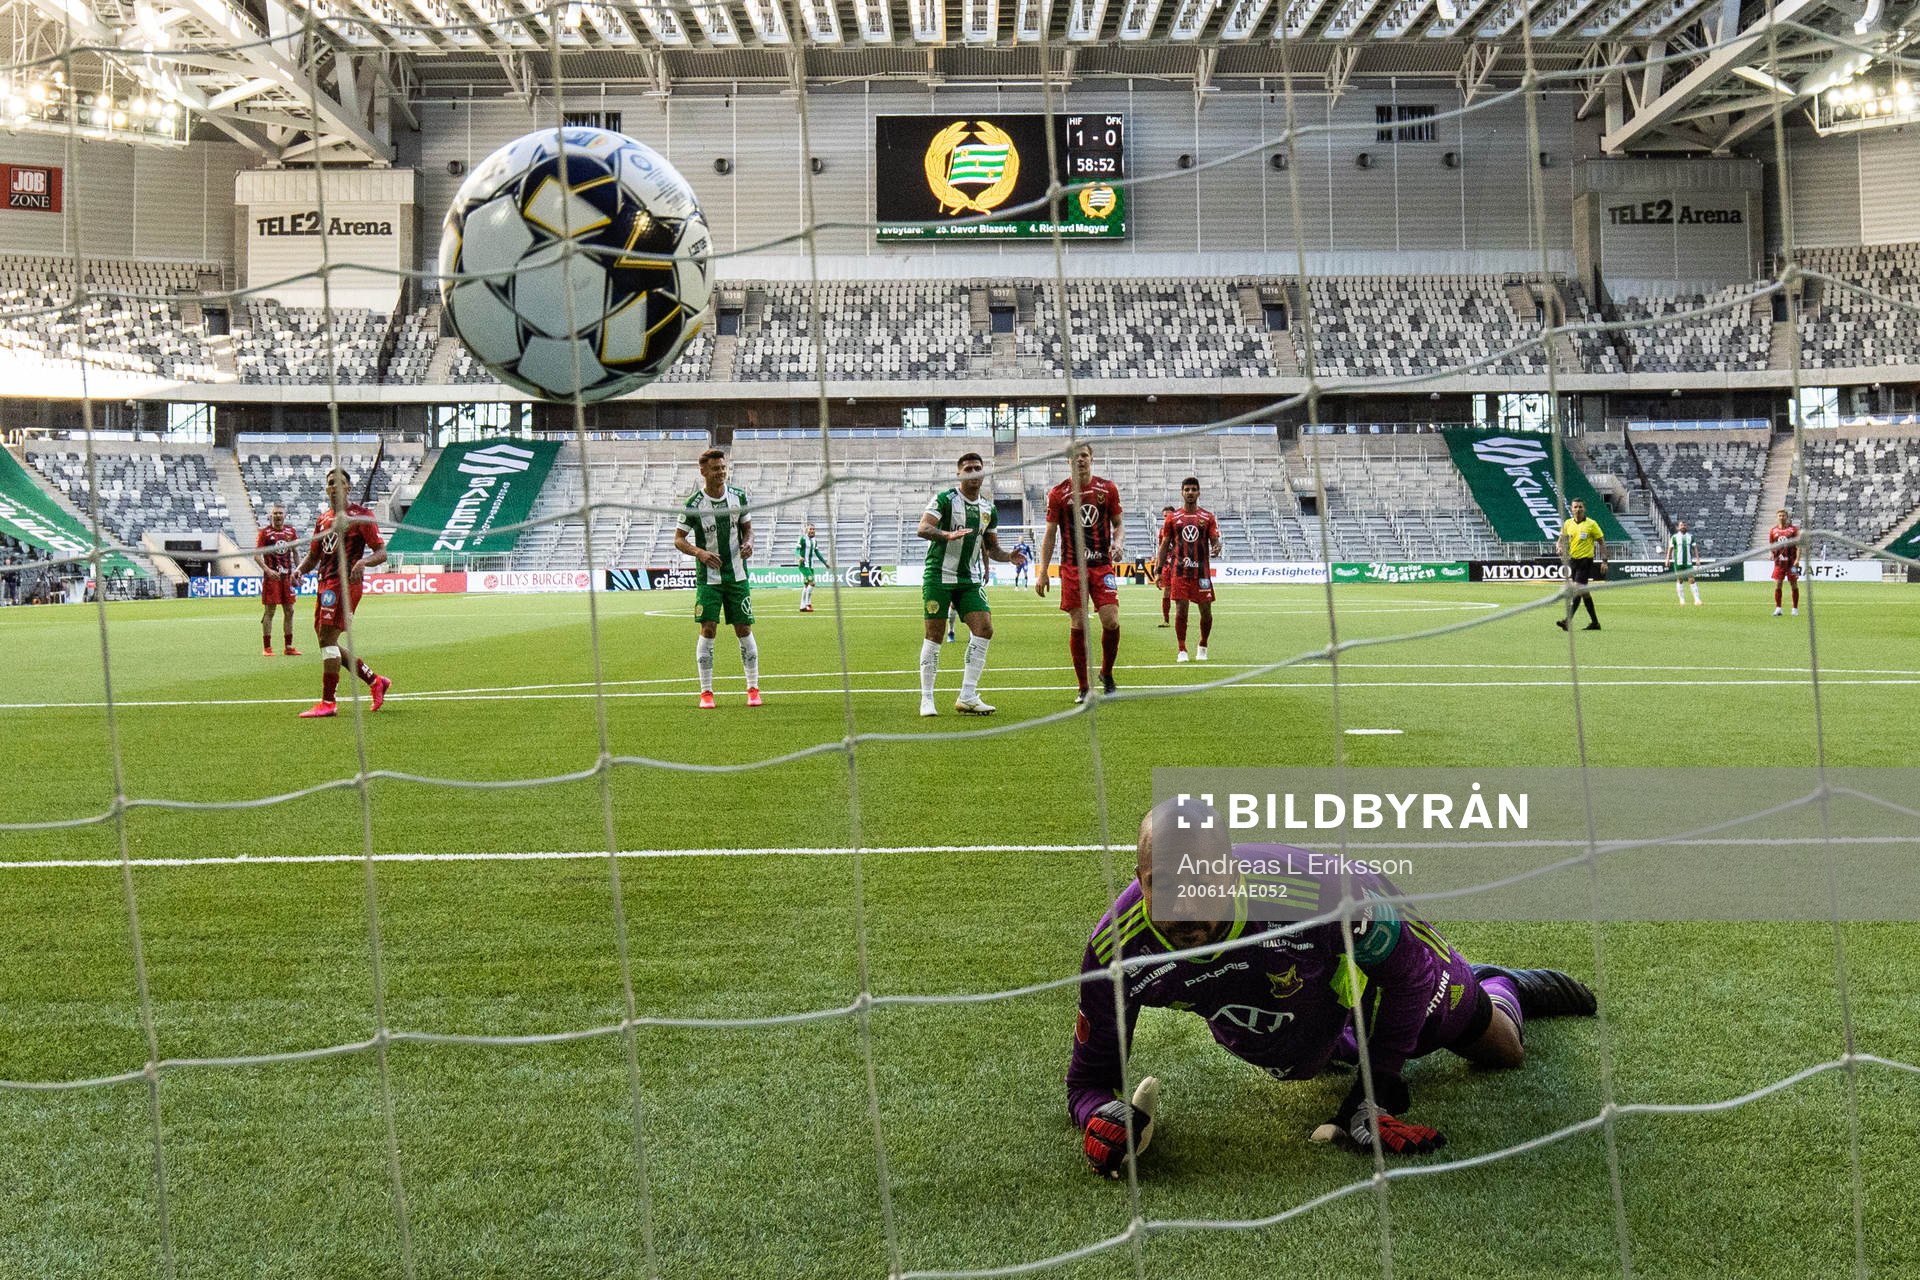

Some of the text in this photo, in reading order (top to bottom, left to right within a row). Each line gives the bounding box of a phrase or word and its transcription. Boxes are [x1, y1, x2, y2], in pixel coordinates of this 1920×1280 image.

[1069, 115, 1122, 126] HIF ÖFK
[1076, 130, 1083, 146] 1
[1105, 130, 1116, 146] 0
[1077, 158, 1116, 172] 58:52
[13, 170, 45, 192] JOB
[10, 194, 50, 208] ZONE
[1608, 200, 1743, 224] TELE2 Arena
[256, 210, 392, 236] TELE2 Arena
[950, 225, 977, 234] Davor
[980, 224, 1018, 234] Blazevic
[1029, 223, 1038, 233] 4.
[1076, 223, 1109, 235] Magyar
[532, 572, 574, 586] BURGER
[748, 571, 800, 584] Audicom
[1225, 567, 1259, 576] Stena
[1261, 566, 1327, 578] Fastigheter
[209, 578, 235, 596] THE
[362, 574, 438, 593] Scandic
[1185, 961, 1250, 987] POLARIS
